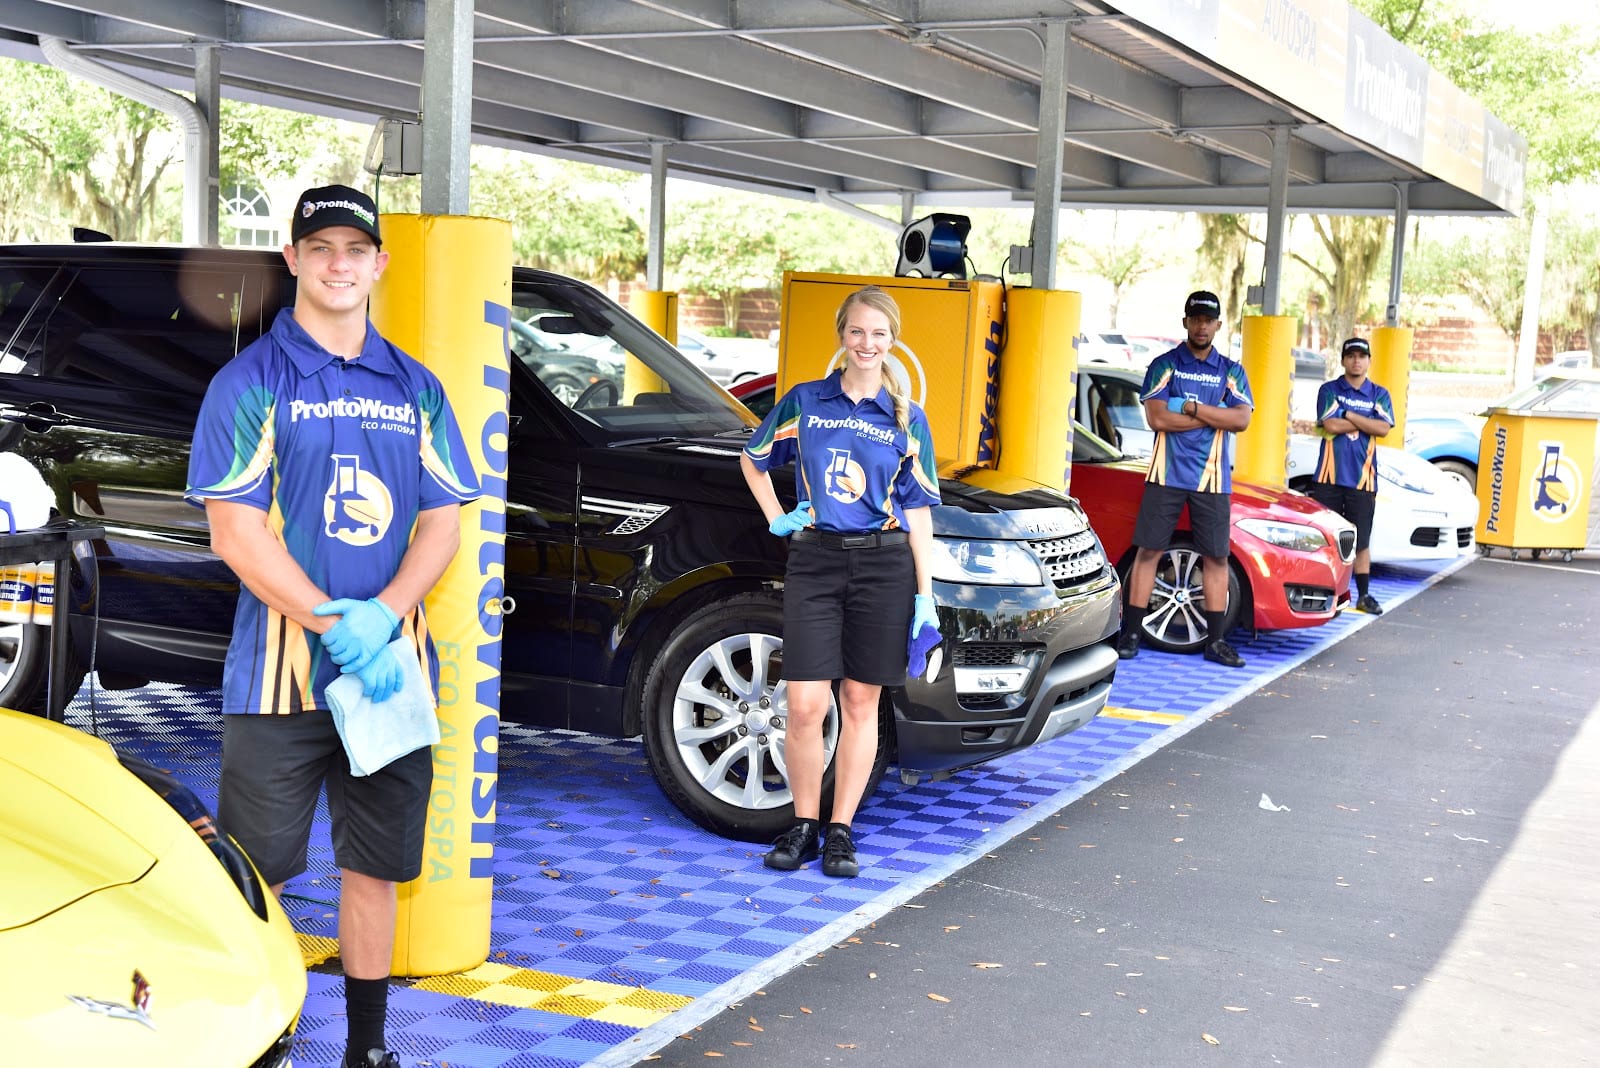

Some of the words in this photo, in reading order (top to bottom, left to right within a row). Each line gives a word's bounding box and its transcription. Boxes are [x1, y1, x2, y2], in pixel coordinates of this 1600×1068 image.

[1262, 0, 1317, 66] AUTOSPA
[1354, 34, 1422, 139] ProntoWash
[288, 397, 417, 424] ProntoWash
[361, 421, 378, 430] ECO
[381, 423, 415, 436] AUTOSPA
[807, 415, 895, 443] ProntoWash
[1486, 427, 1507, 532] ProntoWash
[436, 639, 461, 707] ECO
[427, 725, 459, 884] AUTOSPA
